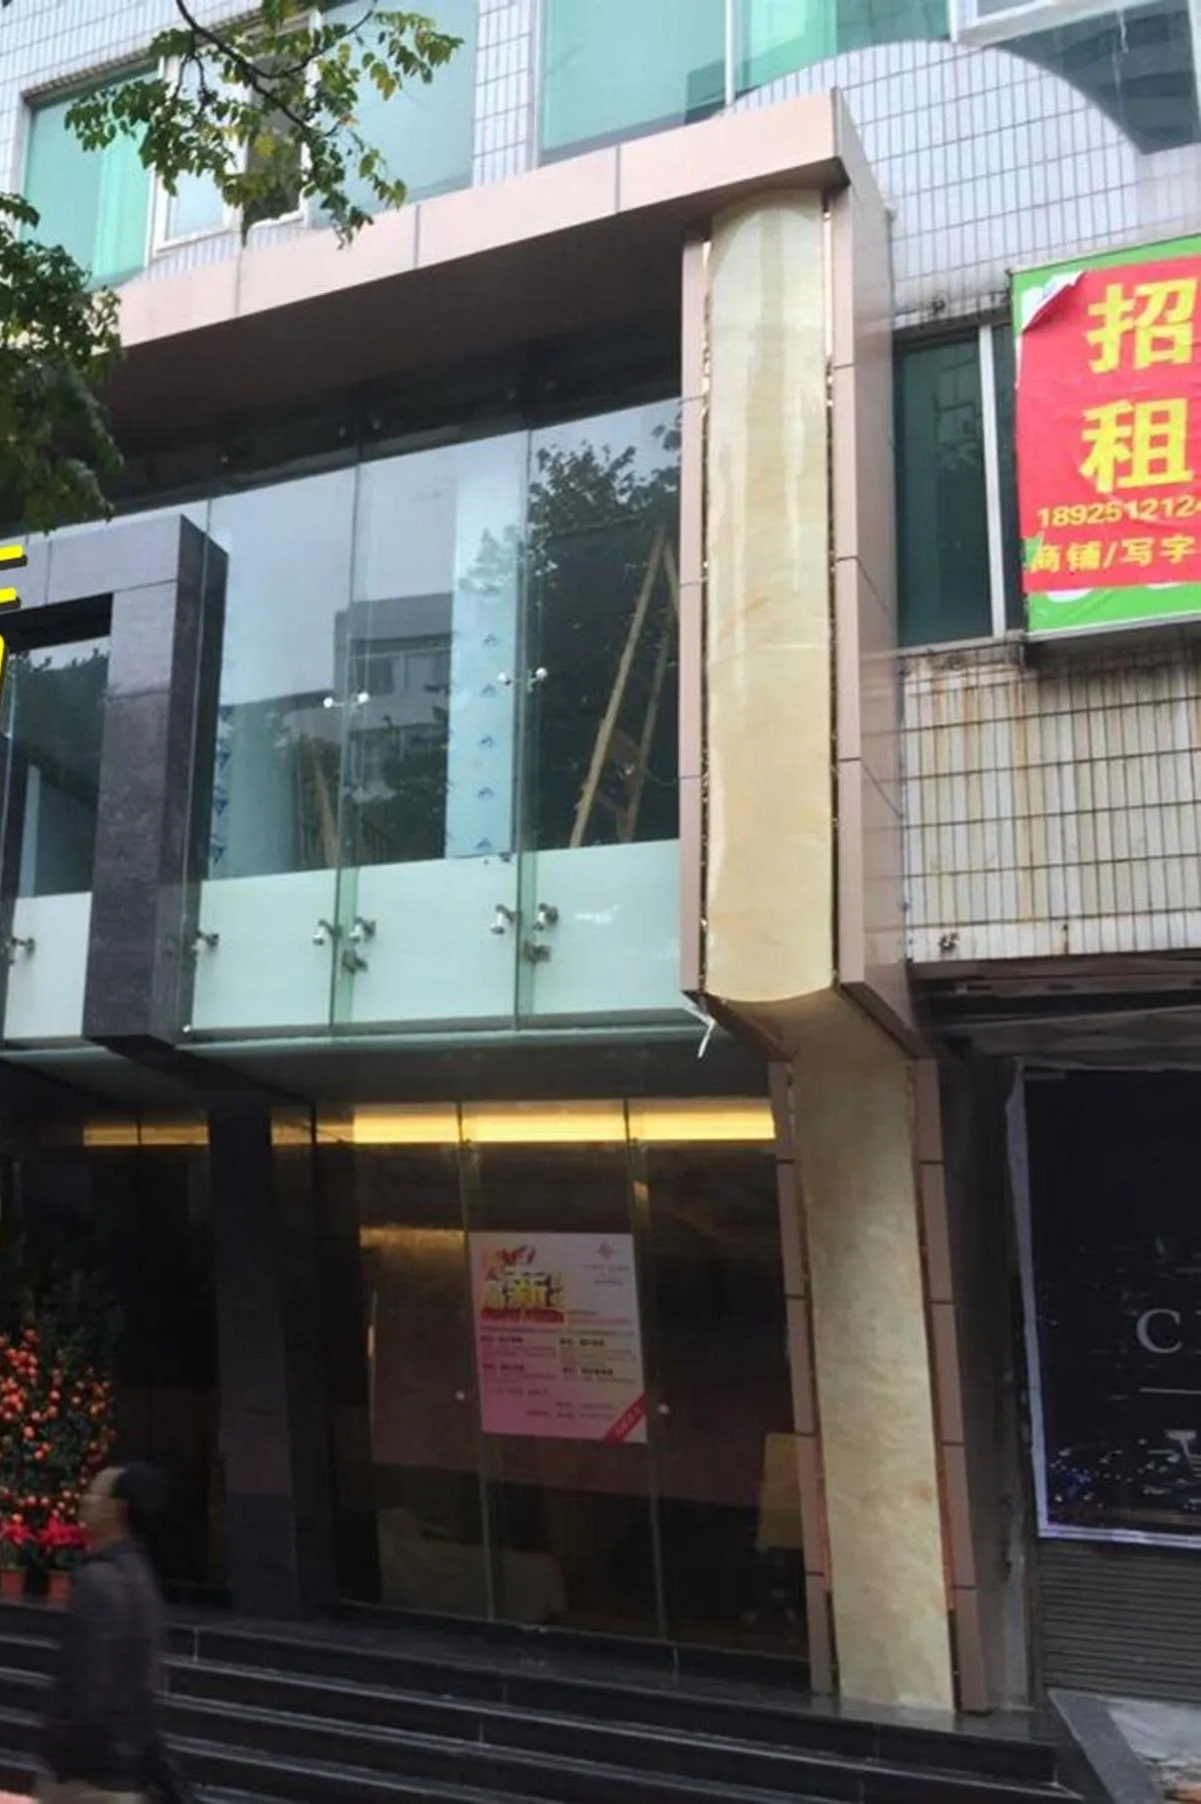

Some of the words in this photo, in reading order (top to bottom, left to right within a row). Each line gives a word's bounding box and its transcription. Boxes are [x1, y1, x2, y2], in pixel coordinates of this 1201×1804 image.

[1080, 277, 1198, 494] 招租
[1037, 494, 1201, 528] 189251212
[1136, 1307, 1201, 1354] C
